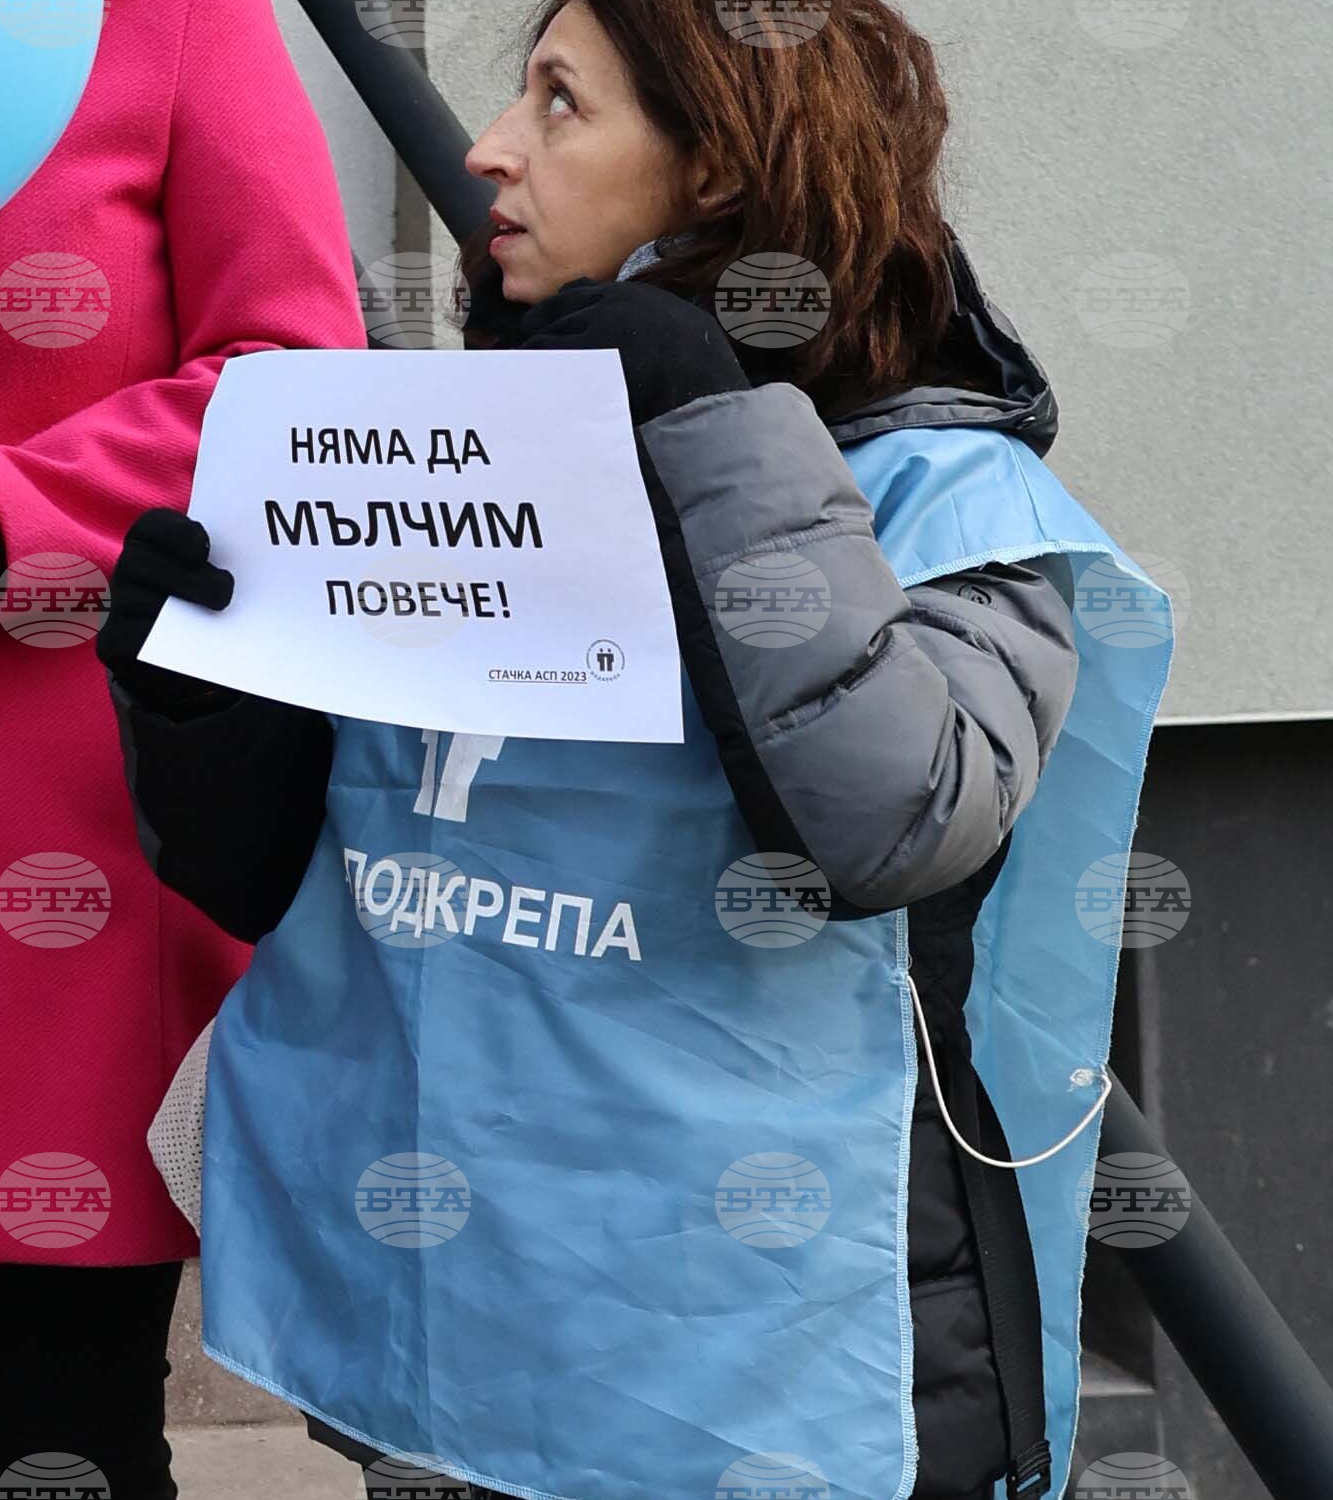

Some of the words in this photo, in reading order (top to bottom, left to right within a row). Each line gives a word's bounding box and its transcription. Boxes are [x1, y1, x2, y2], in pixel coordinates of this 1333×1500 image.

[290, 426, 415, 466] НЯМА
[427, 428, 491, 474] ДА
[264, 499, 544, 550] МЪЛЧИМ
[326, 579, 511, 619] ПОВЕЧЕ!
[488, 667, 532, 681] СТАЧКА
[534, 669, 559, 682] АСП
[560, 669, 588, 683] 2023
[342, 846, 643, 962] ПОДКРЕПА
